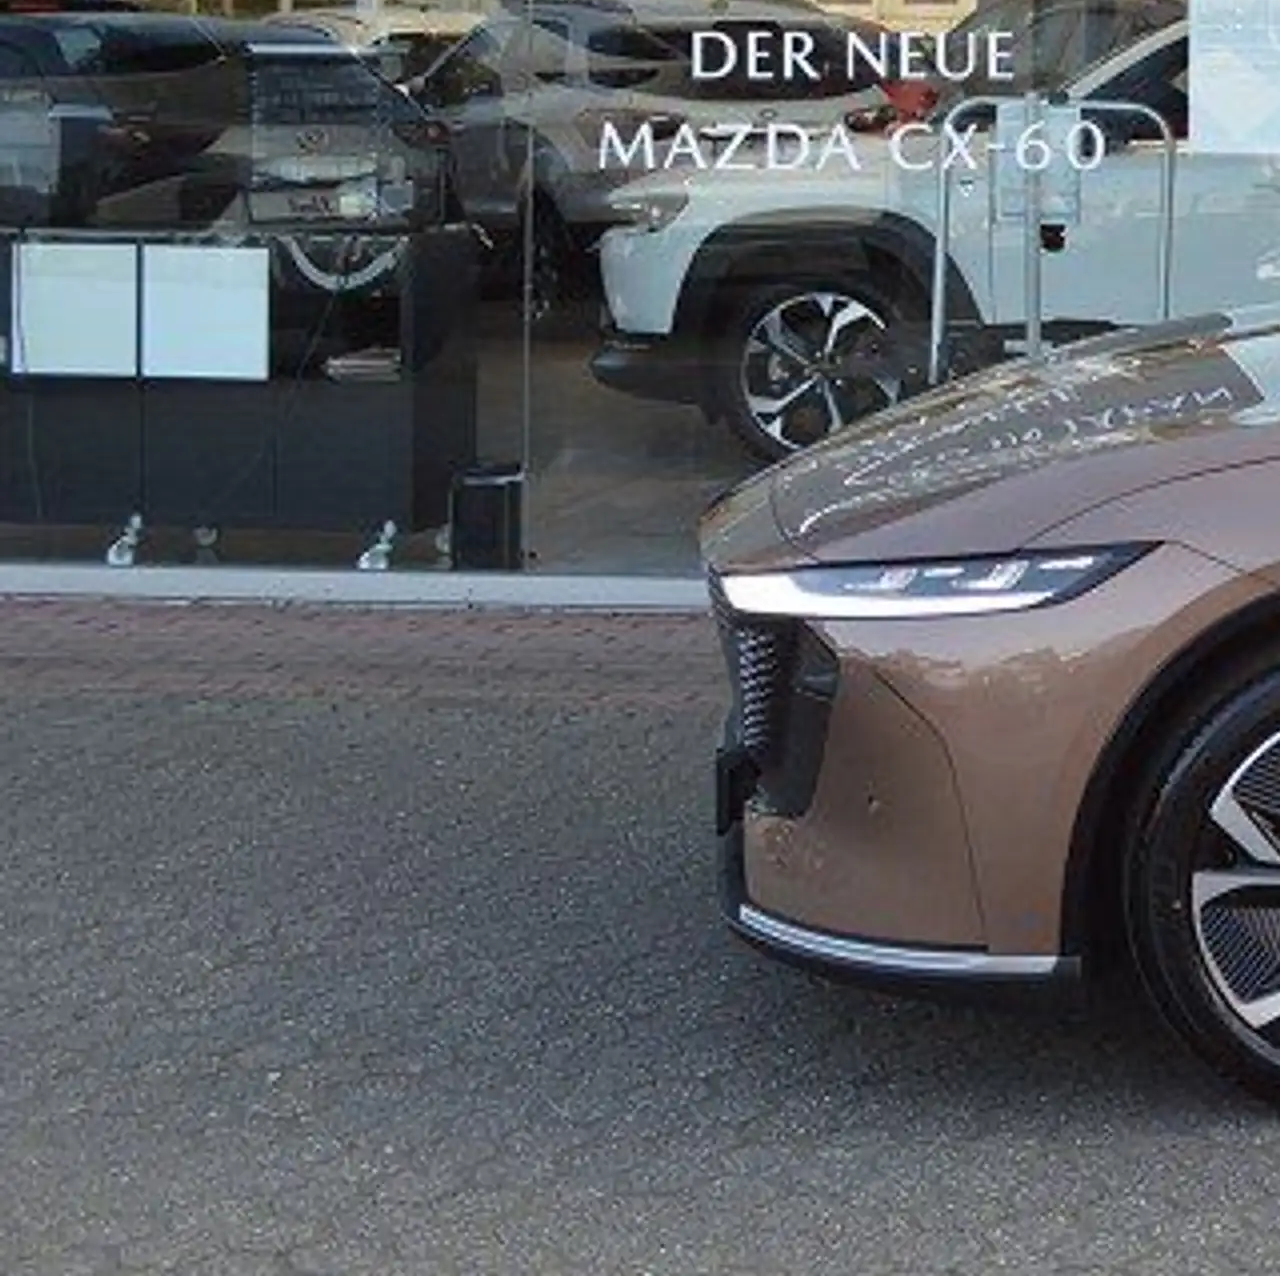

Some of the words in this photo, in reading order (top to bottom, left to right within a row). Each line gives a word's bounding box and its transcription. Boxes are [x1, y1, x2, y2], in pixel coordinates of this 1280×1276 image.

[692, 30, 816, 81] DER
[846, 31, 1014, 81] NEUE
[598, 123, 861, 172] MAZDA
[890, 121, 1106, 171] CX-60
